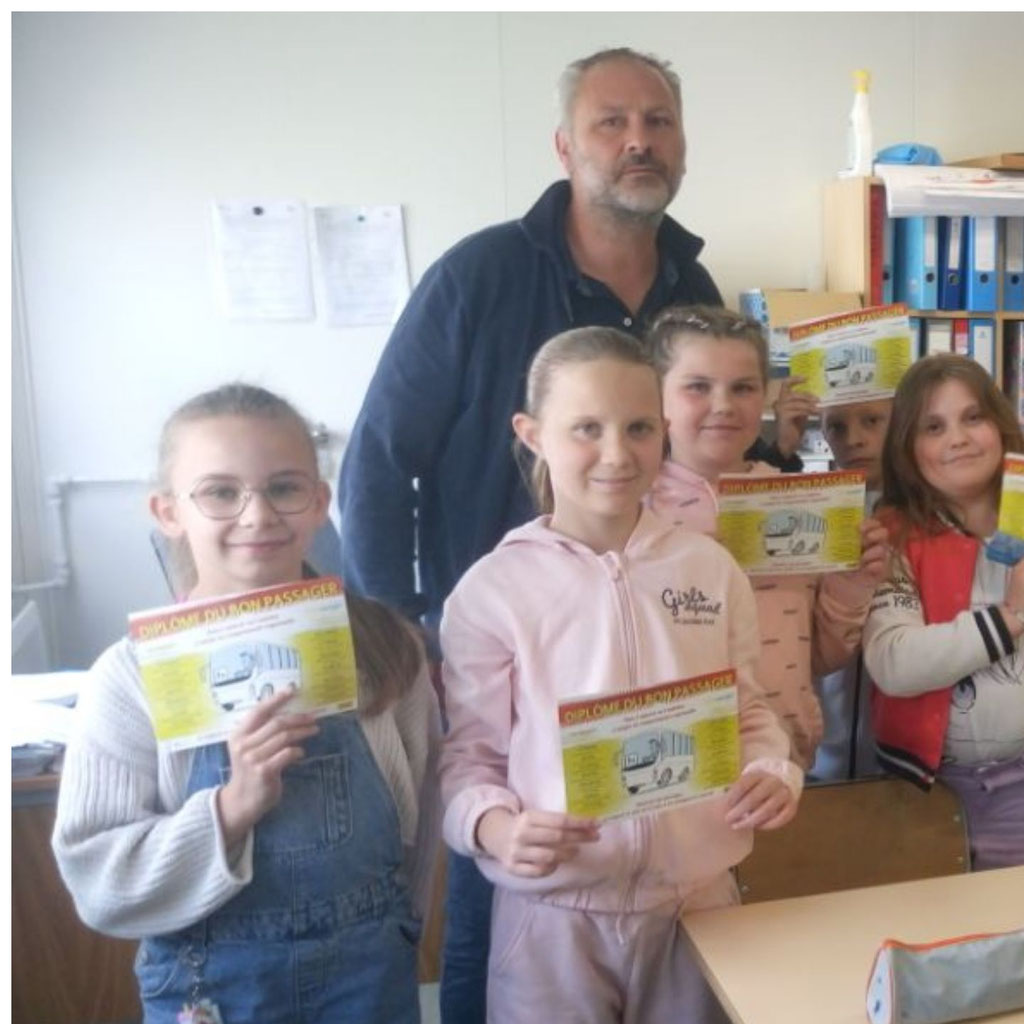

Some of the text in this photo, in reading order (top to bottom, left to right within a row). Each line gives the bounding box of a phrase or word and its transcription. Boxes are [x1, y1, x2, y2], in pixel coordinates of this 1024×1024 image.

[204, 607, 228, 623] DU
[229, 600, 261, 617] BON
[265, 583, 338, 607] PASSAGER
[624, 697, 643, 711] DU
